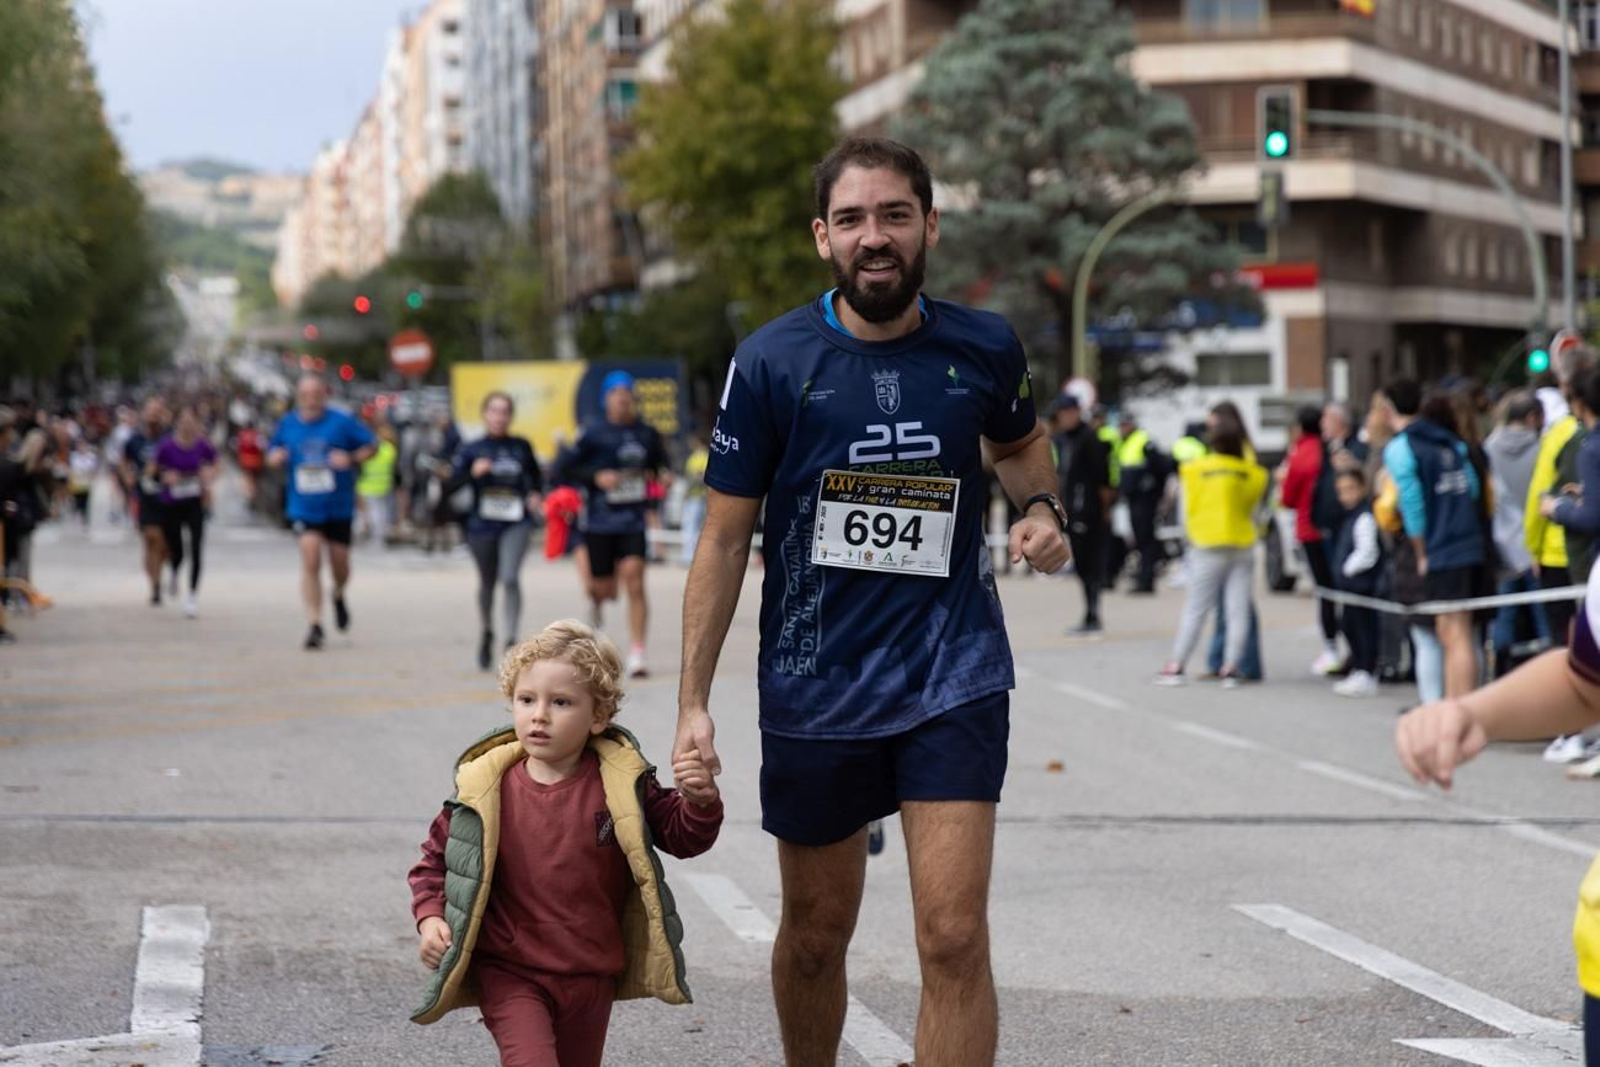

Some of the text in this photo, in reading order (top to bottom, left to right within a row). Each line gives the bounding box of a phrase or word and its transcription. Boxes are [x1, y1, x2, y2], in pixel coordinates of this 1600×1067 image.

[848, 421, 941, 464] 25
[849, 460, 940, 474] CARRERA
[826, 473, 954, 492] XXV CARRERA POPULAR
[869, 484, 896, 495] gran
[901, 486, 951, 500] caminata
[843, 510, 923, 551] 694
[800, 628, 816, 652] DE
